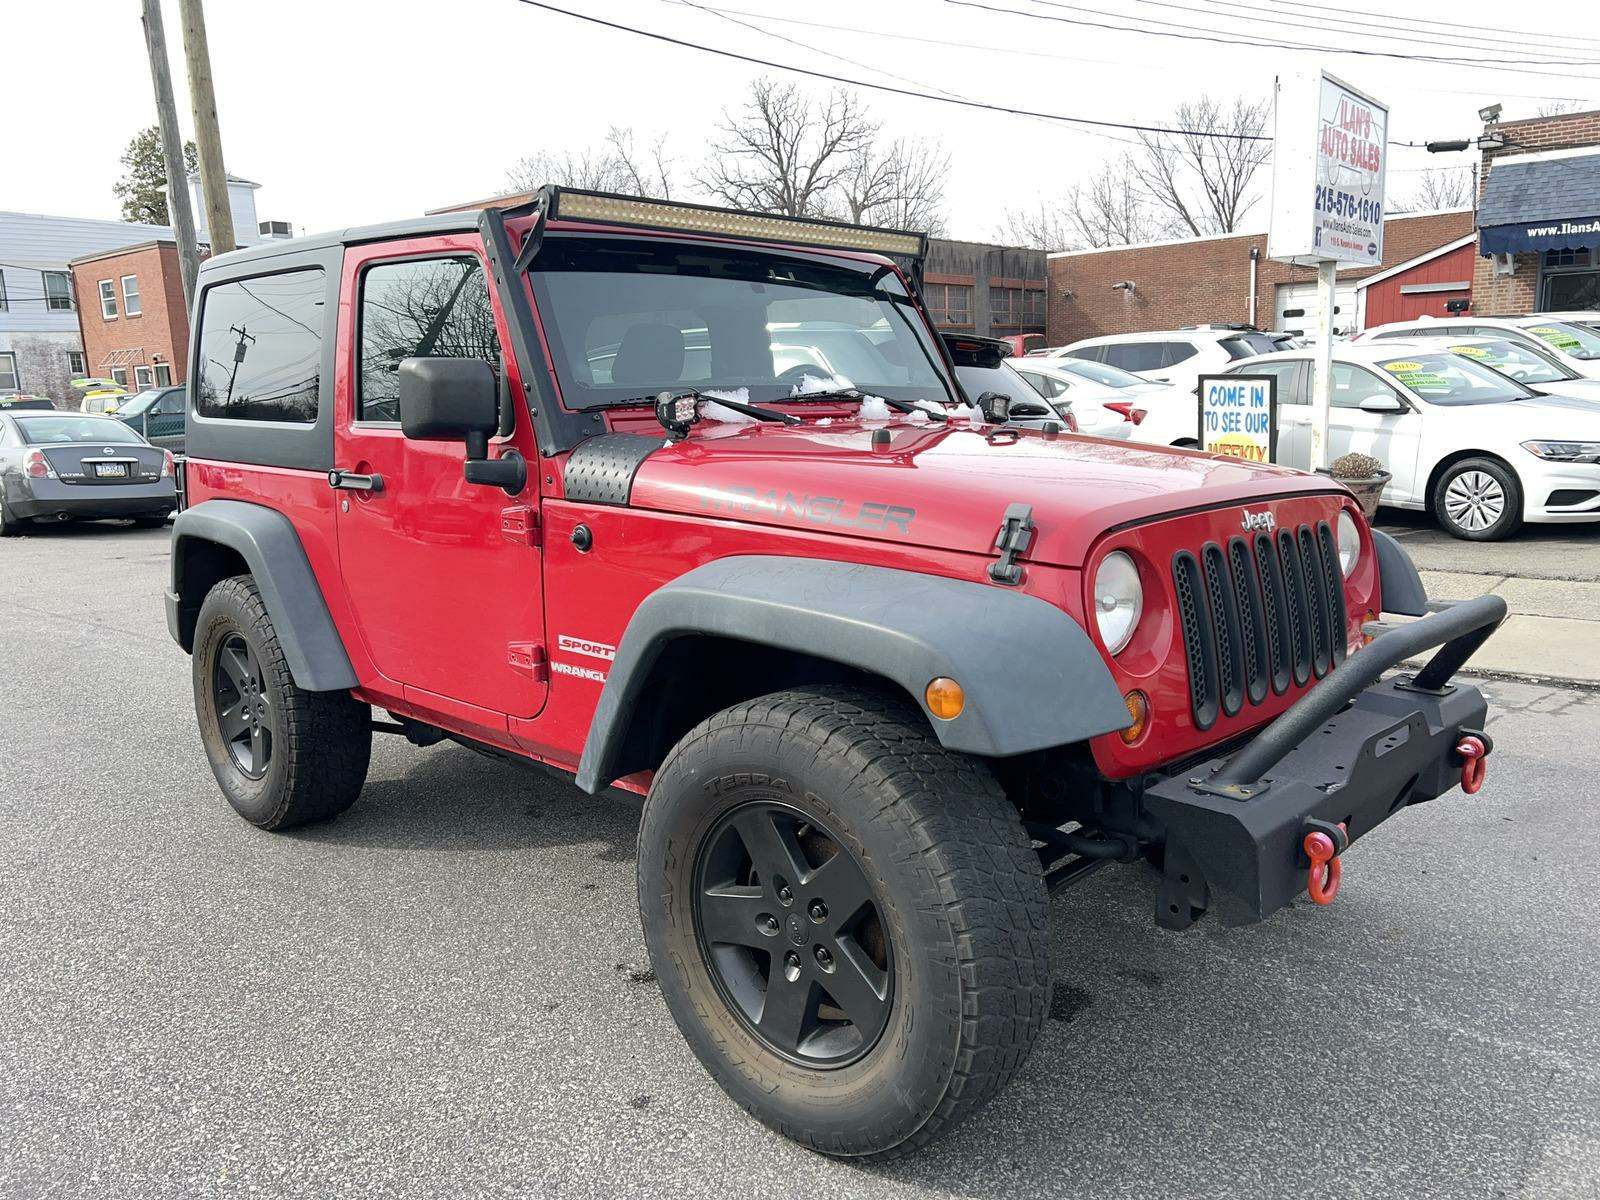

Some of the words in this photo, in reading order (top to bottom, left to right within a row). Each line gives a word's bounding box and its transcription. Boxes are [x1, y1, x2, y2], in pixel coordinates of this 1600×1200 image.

[1340, 99, 1371, 139] ILAN'S
[1321, 124, 1348, 162] AUTO
[1350, 136, 1380, 173] SALES
[1315, 184, 1380, 225] 215-576-1610
[1209, 386, 1245, 407] COME
[1250, 386, 1264, 408] IN
[1204, 411, 1218, 432] TO
[1221, 412, 1241, 432] SEE
[1245, 412, 1268, 433] OUR
[698, 484, 916, 535] WRANGLER
[1241, 508, 1275, 532] Jeep
[559, 639, 615, 656] SPORT
